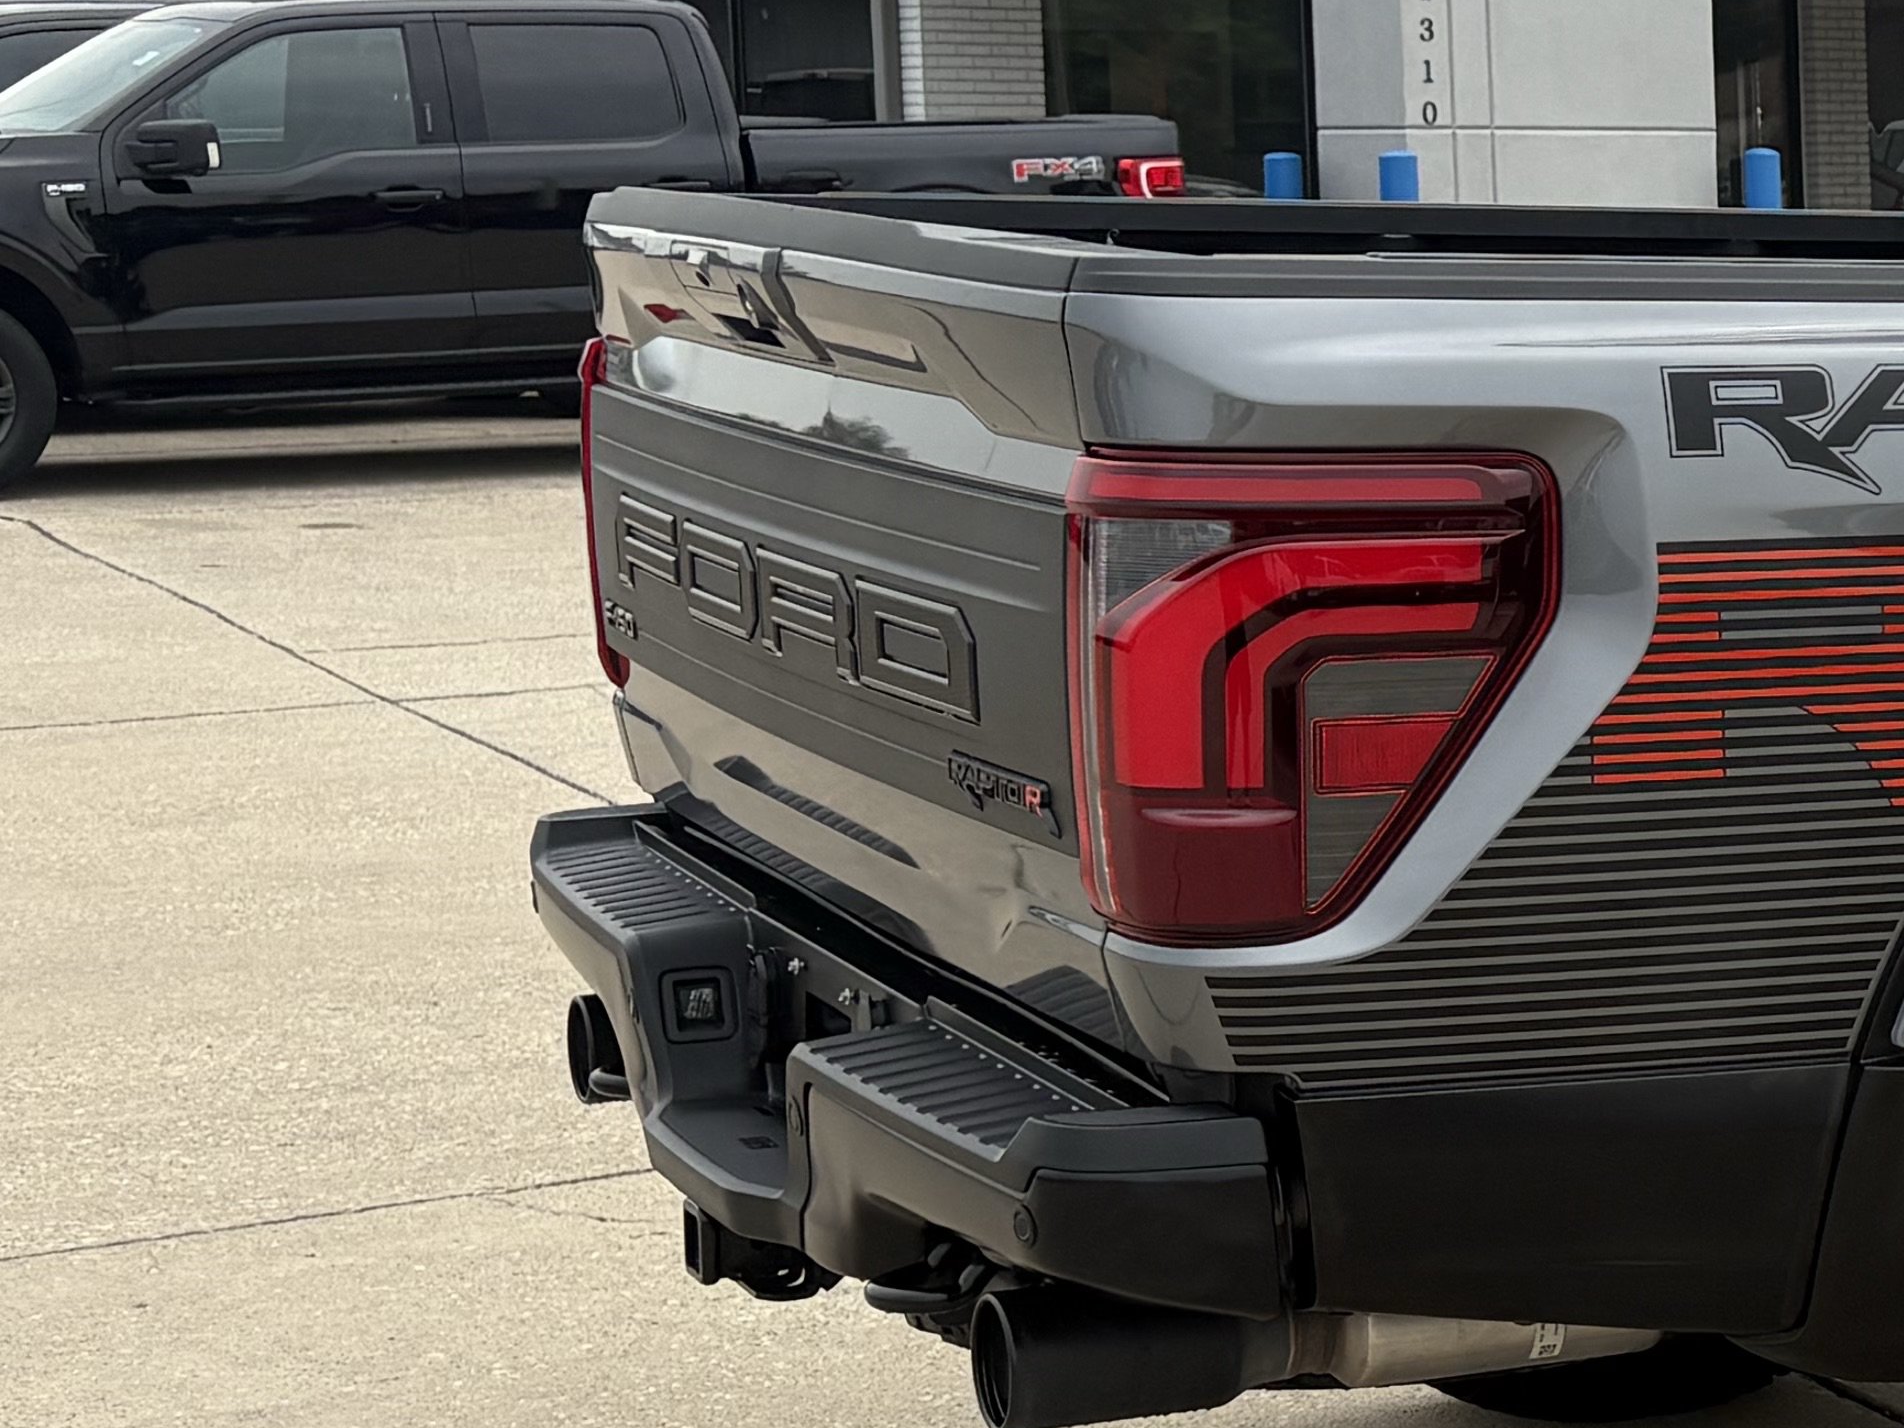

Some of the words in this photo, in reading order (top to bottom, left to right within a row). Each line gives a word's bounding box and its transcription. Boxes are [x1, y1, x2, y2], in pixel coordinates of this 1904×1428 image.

[1012, 155, 1104, 183] FX4
[615, 492, 981, 726] FORD
[949, 749, 1062, 839] RAPTOR
